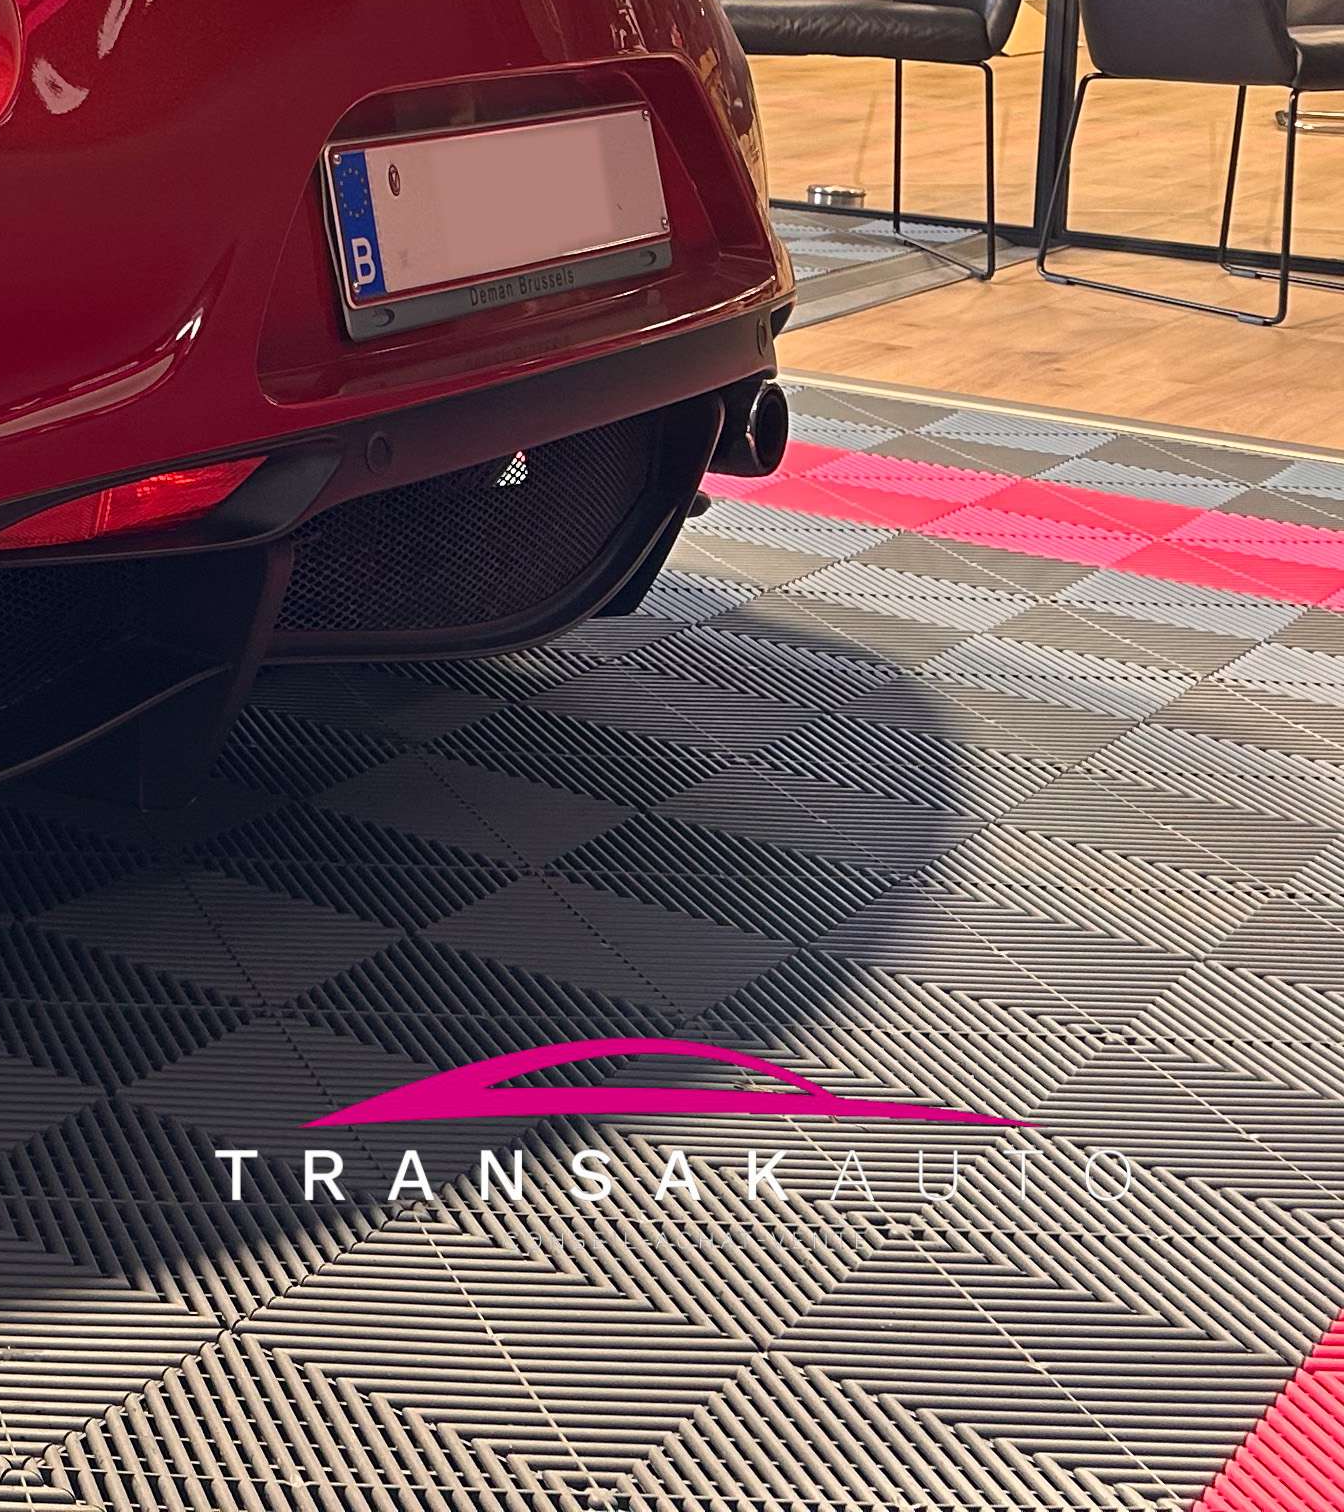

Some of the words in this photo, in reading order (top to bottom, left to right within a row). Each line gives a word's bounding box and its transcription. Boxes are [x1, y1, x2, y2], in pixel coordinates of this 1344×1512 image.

[351, 236, 376, 286] B
[470, 283, 513, 307] Deman
[518, 267, 576, 296] Brussels
